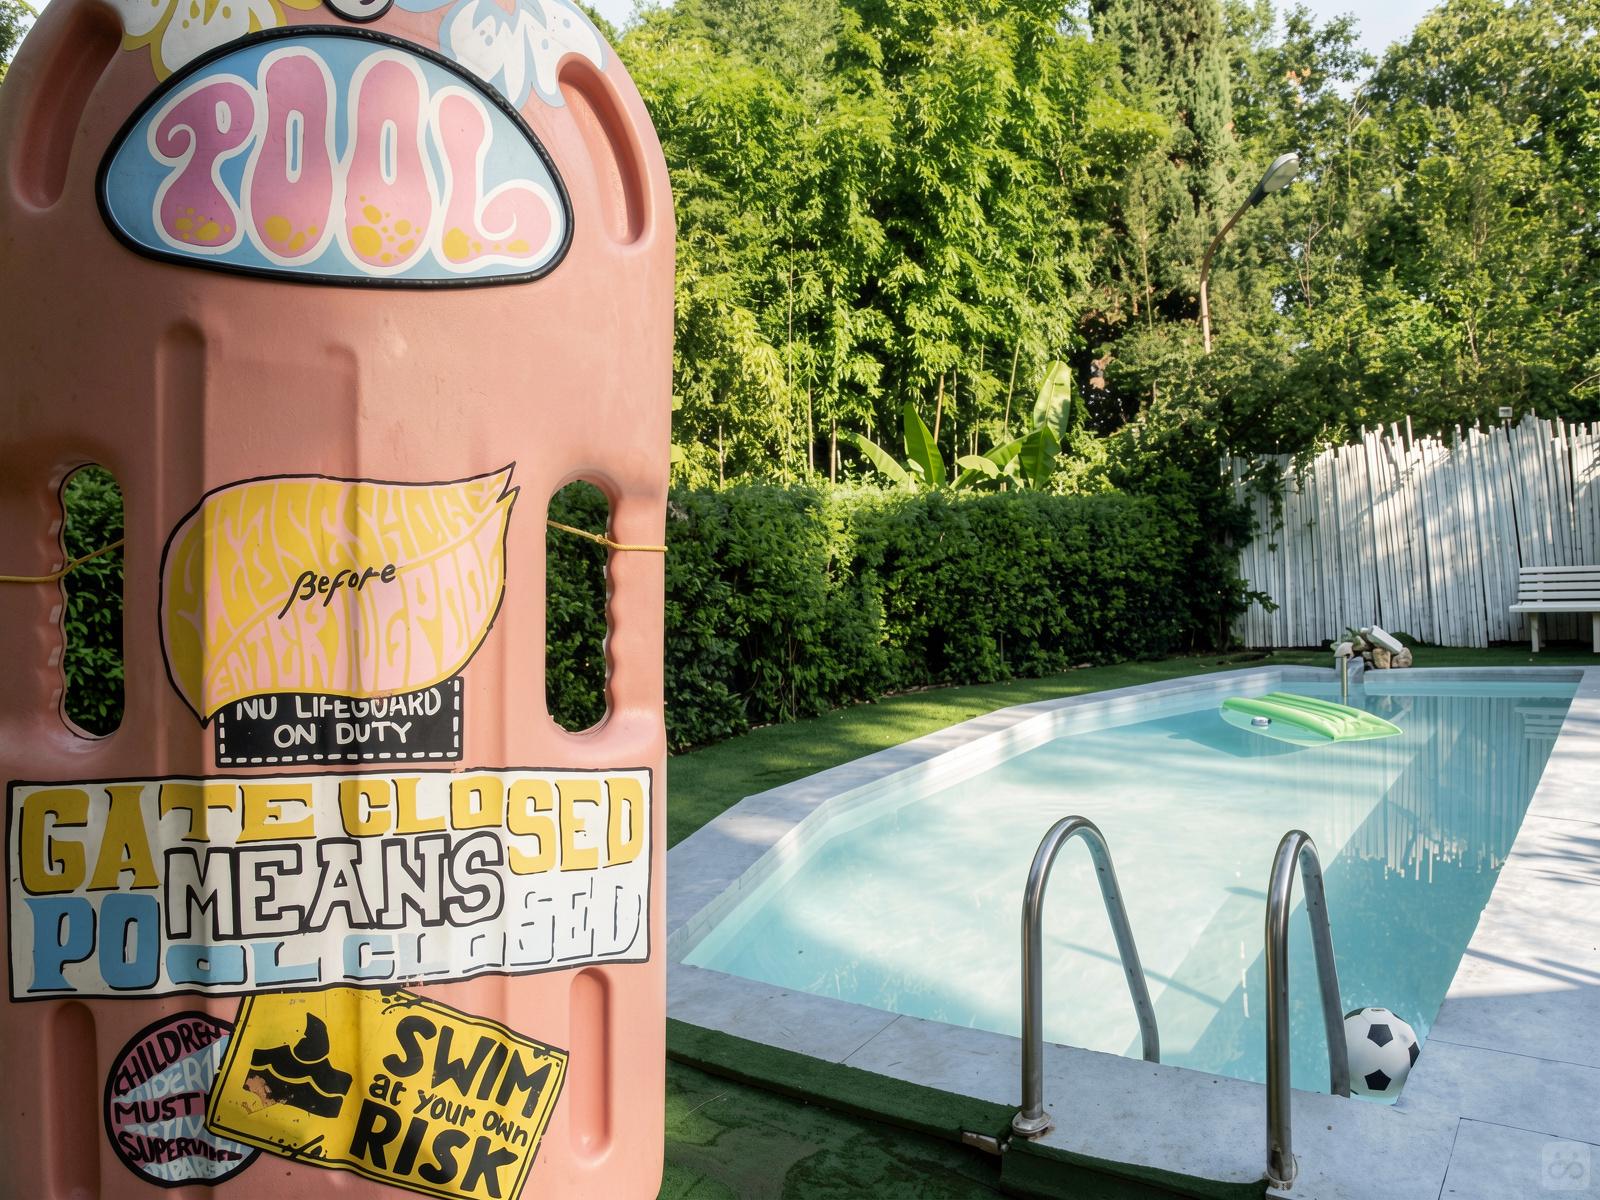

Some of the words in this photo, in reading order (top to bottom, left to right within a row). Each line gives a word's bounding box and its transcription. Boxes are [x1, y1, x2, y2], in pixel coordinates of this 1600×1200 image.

[147, 46, 558, 274] POOL
[273, 722, 317, 748] ON
[336, 721, 413, 745] DUTY
[295, 687, 441, 719] LIFEGUARD
[21, 783, 319, 895] GATE
[337, 776, 645, 875] CLOSED
[163, 831, 506, 941] MEANS
[24, 893, 322, 992] POOL
[342, 883, 641, 981] CLOSED
[114, 1021, 222, 1097] CHILDREN
[114, 1092, 201, 1124] MUST
[382, 1015, 552, 1119] SWIM
[349, 1098, 519, 1199] RISK
[369, 1073, 407, 1106] at
[413, 1089, 476, 1127] your
[482, 1110, 529, 1147] own
